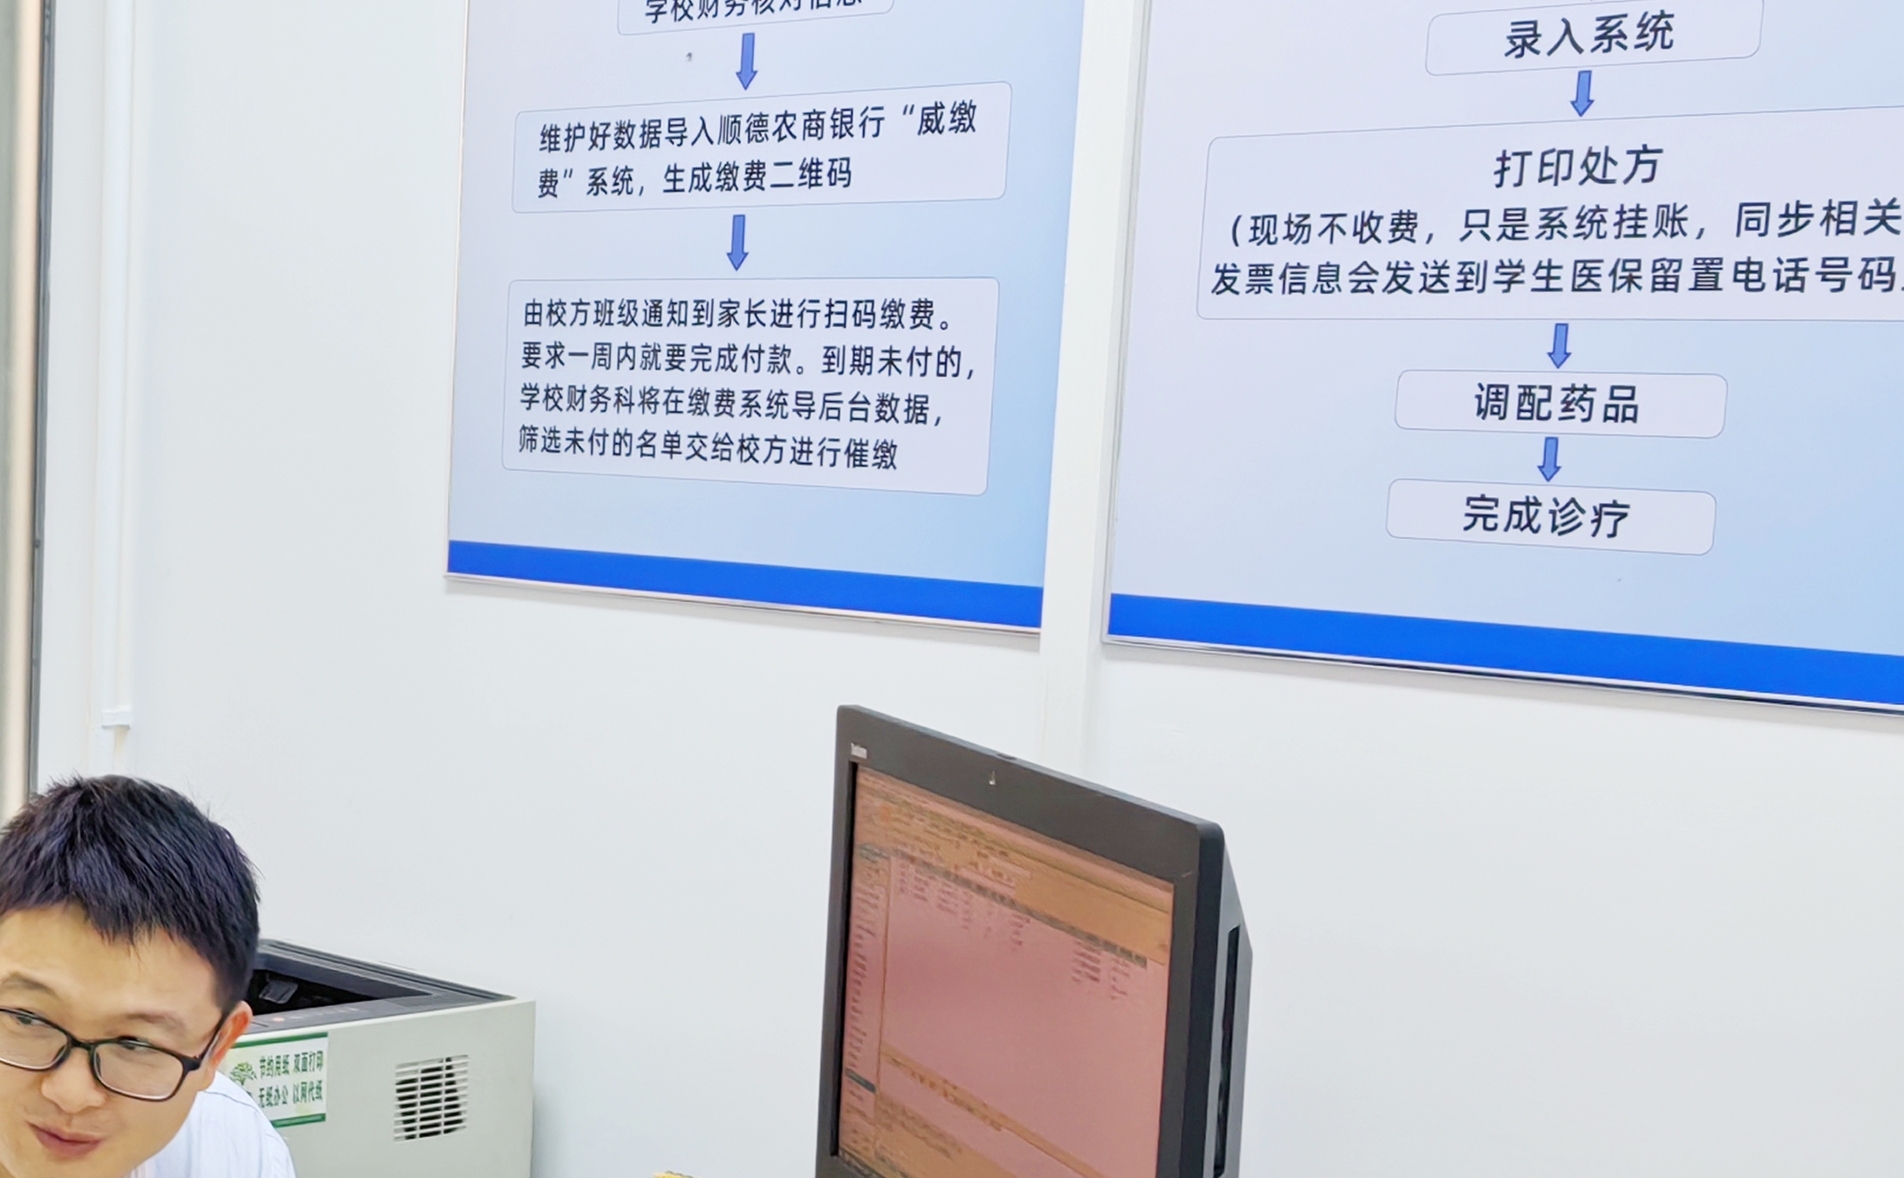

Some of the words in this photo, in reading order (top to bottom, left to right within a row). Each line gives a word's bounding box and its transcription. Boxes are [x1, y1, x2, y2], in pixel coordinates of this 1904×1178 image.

[645, 0, 862, 24] 学校财务
[1504, 9, 1675, 59] 录入系统
[537, 157, 853, 199] 费”系统，生成缴费二维码
[1493, 143, 1664, 189] 打印处方
[1231, 197, 1902, 247] （现场不收费，只是系统挂账，同步相关
[1211, 256, 1904, 296] 发票信息会发送到学生医保留置电话号码
[523, 298, 950, 332] 由校方班级通知到家长进行扫码缴费。
[521, 340, 974, 380] 要求一周内就要完成付款。到期未付的，
[520, 382, 942, 427] 学校财务科将在缴费系统导后台数据，
[1474, 382, 1639, 424] 调配药品
[518, 424, 898, 471] 筛选未付的名单交给校方进行催缴
[1463, 493, 1631, 539] 完成诊疗
